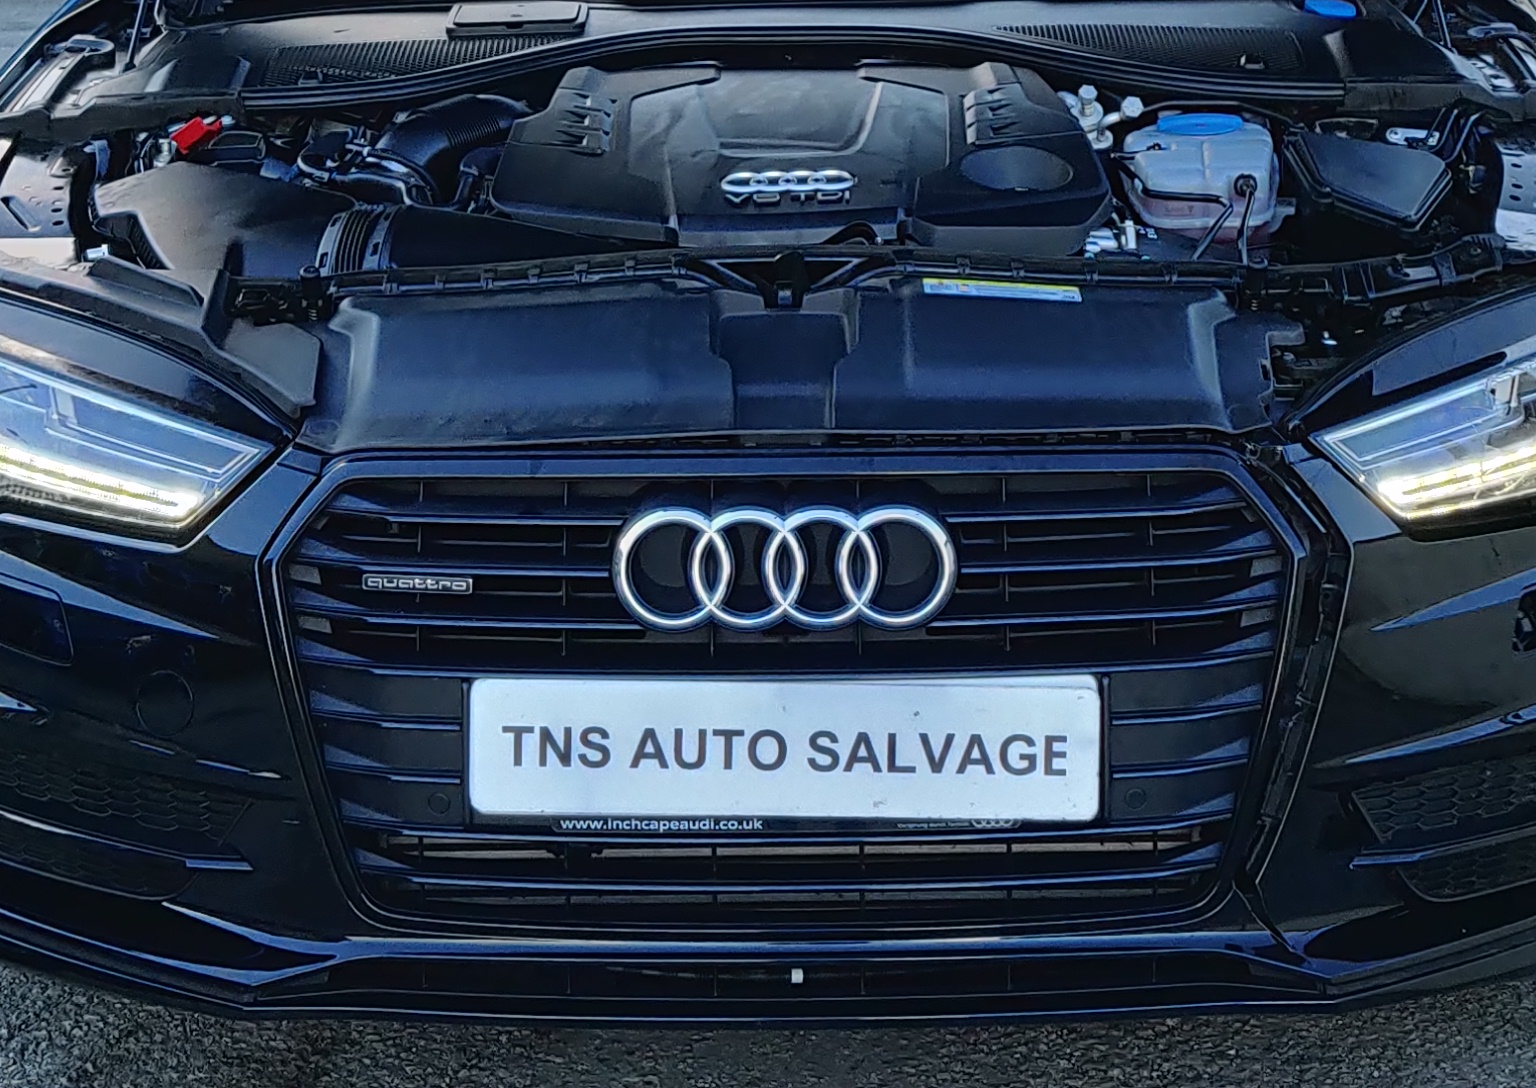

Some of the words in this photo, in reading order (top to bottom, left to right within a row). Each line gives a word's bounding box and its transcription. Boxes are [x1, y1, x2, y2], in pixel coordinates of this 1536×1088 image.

[790, 190, 851, 204] TDI
[366, 577, 468, 591] quattro
[501, 725, 612, 769] TNS
[629, 728, 788, 773] AUTO
[806, 731, 1067, 777] SALVAGE
